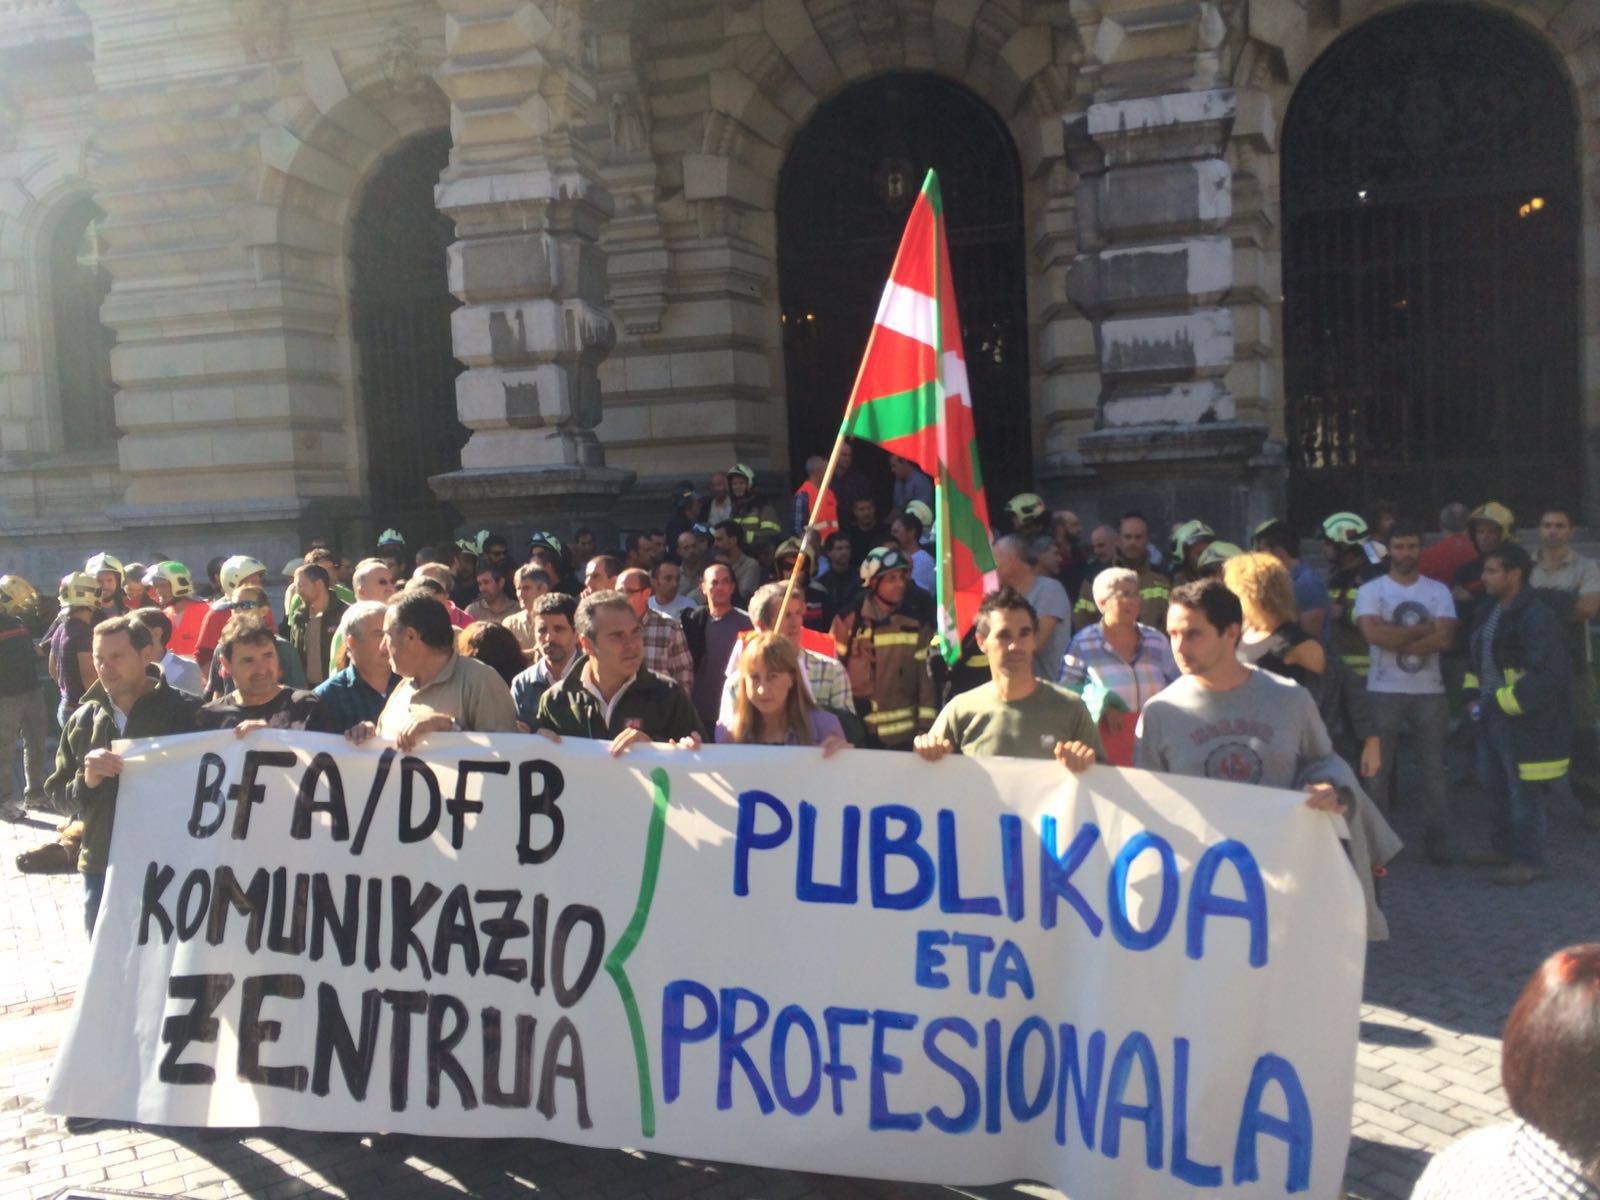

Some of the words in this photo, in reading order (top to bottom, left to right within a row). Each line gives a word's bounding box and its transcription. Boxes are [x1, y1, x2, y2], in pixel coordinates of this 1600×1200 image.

[188, 747, 566, 866] BFA/DFB
[733, 790, 1269, 968] PUBLIKOA
[138, 861, 606, 1009] KOMUNIKAZIO
[915, 929, 1035, 1000] ETA
[158, 973, 593, 1130] ZENTRUA
[661, 979, 1313, 1194] PROFESIONALA
